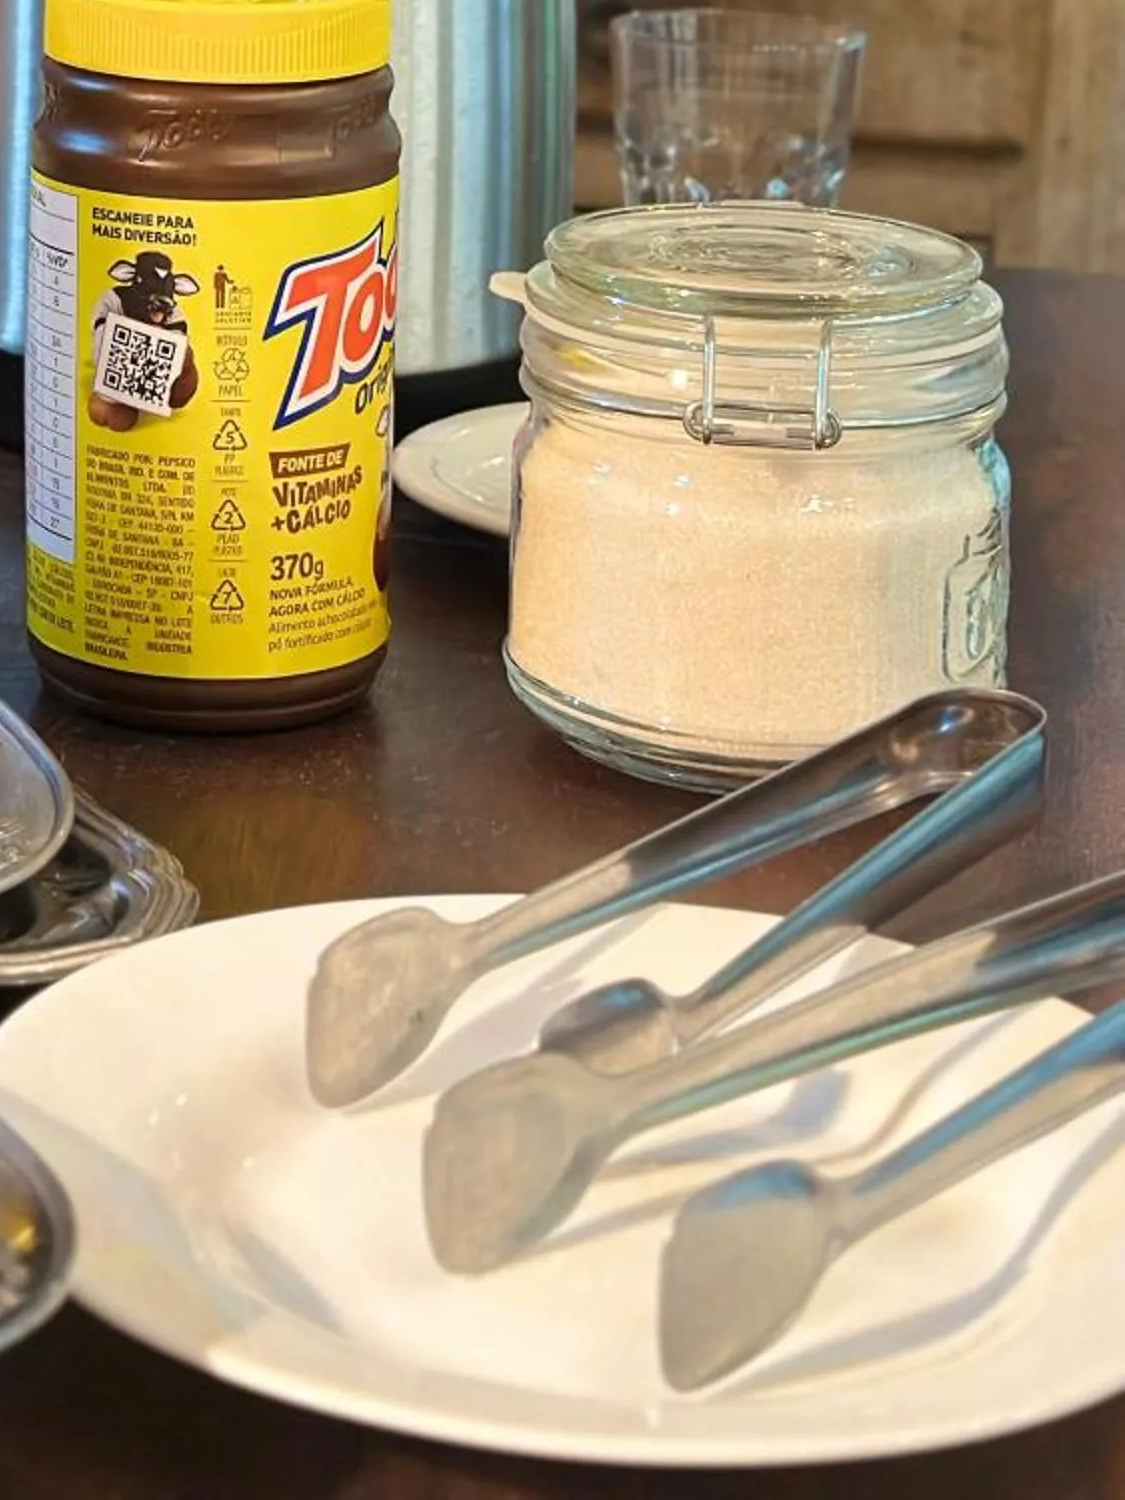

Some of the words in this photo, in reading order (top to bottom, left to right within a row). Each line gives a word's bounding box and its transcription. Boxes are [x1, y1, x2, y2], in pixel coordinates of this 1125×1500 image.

[92, 207, 154, 227] ESCANEIE
[156, 214, 194, 229] PARA
[92, 223, 122, 239] MAIS
[124, 227, 197, 247] DIVERSÃO!
[225, 431, 235, 445] 5
[278, 453, 324, 474] FONTE
[326, 449, 344, 467] DE
[272, 464, 362, 508] VITAMINAS
[225, 511, 233, 524] 2
[270, 551, 324, 581] 370g
[223, 592, 232, 605] 7
[270, 587, 302, 600] NOVA
[268, 602, 309, 618] AGORA
[311, 597, 334, 611] COM
